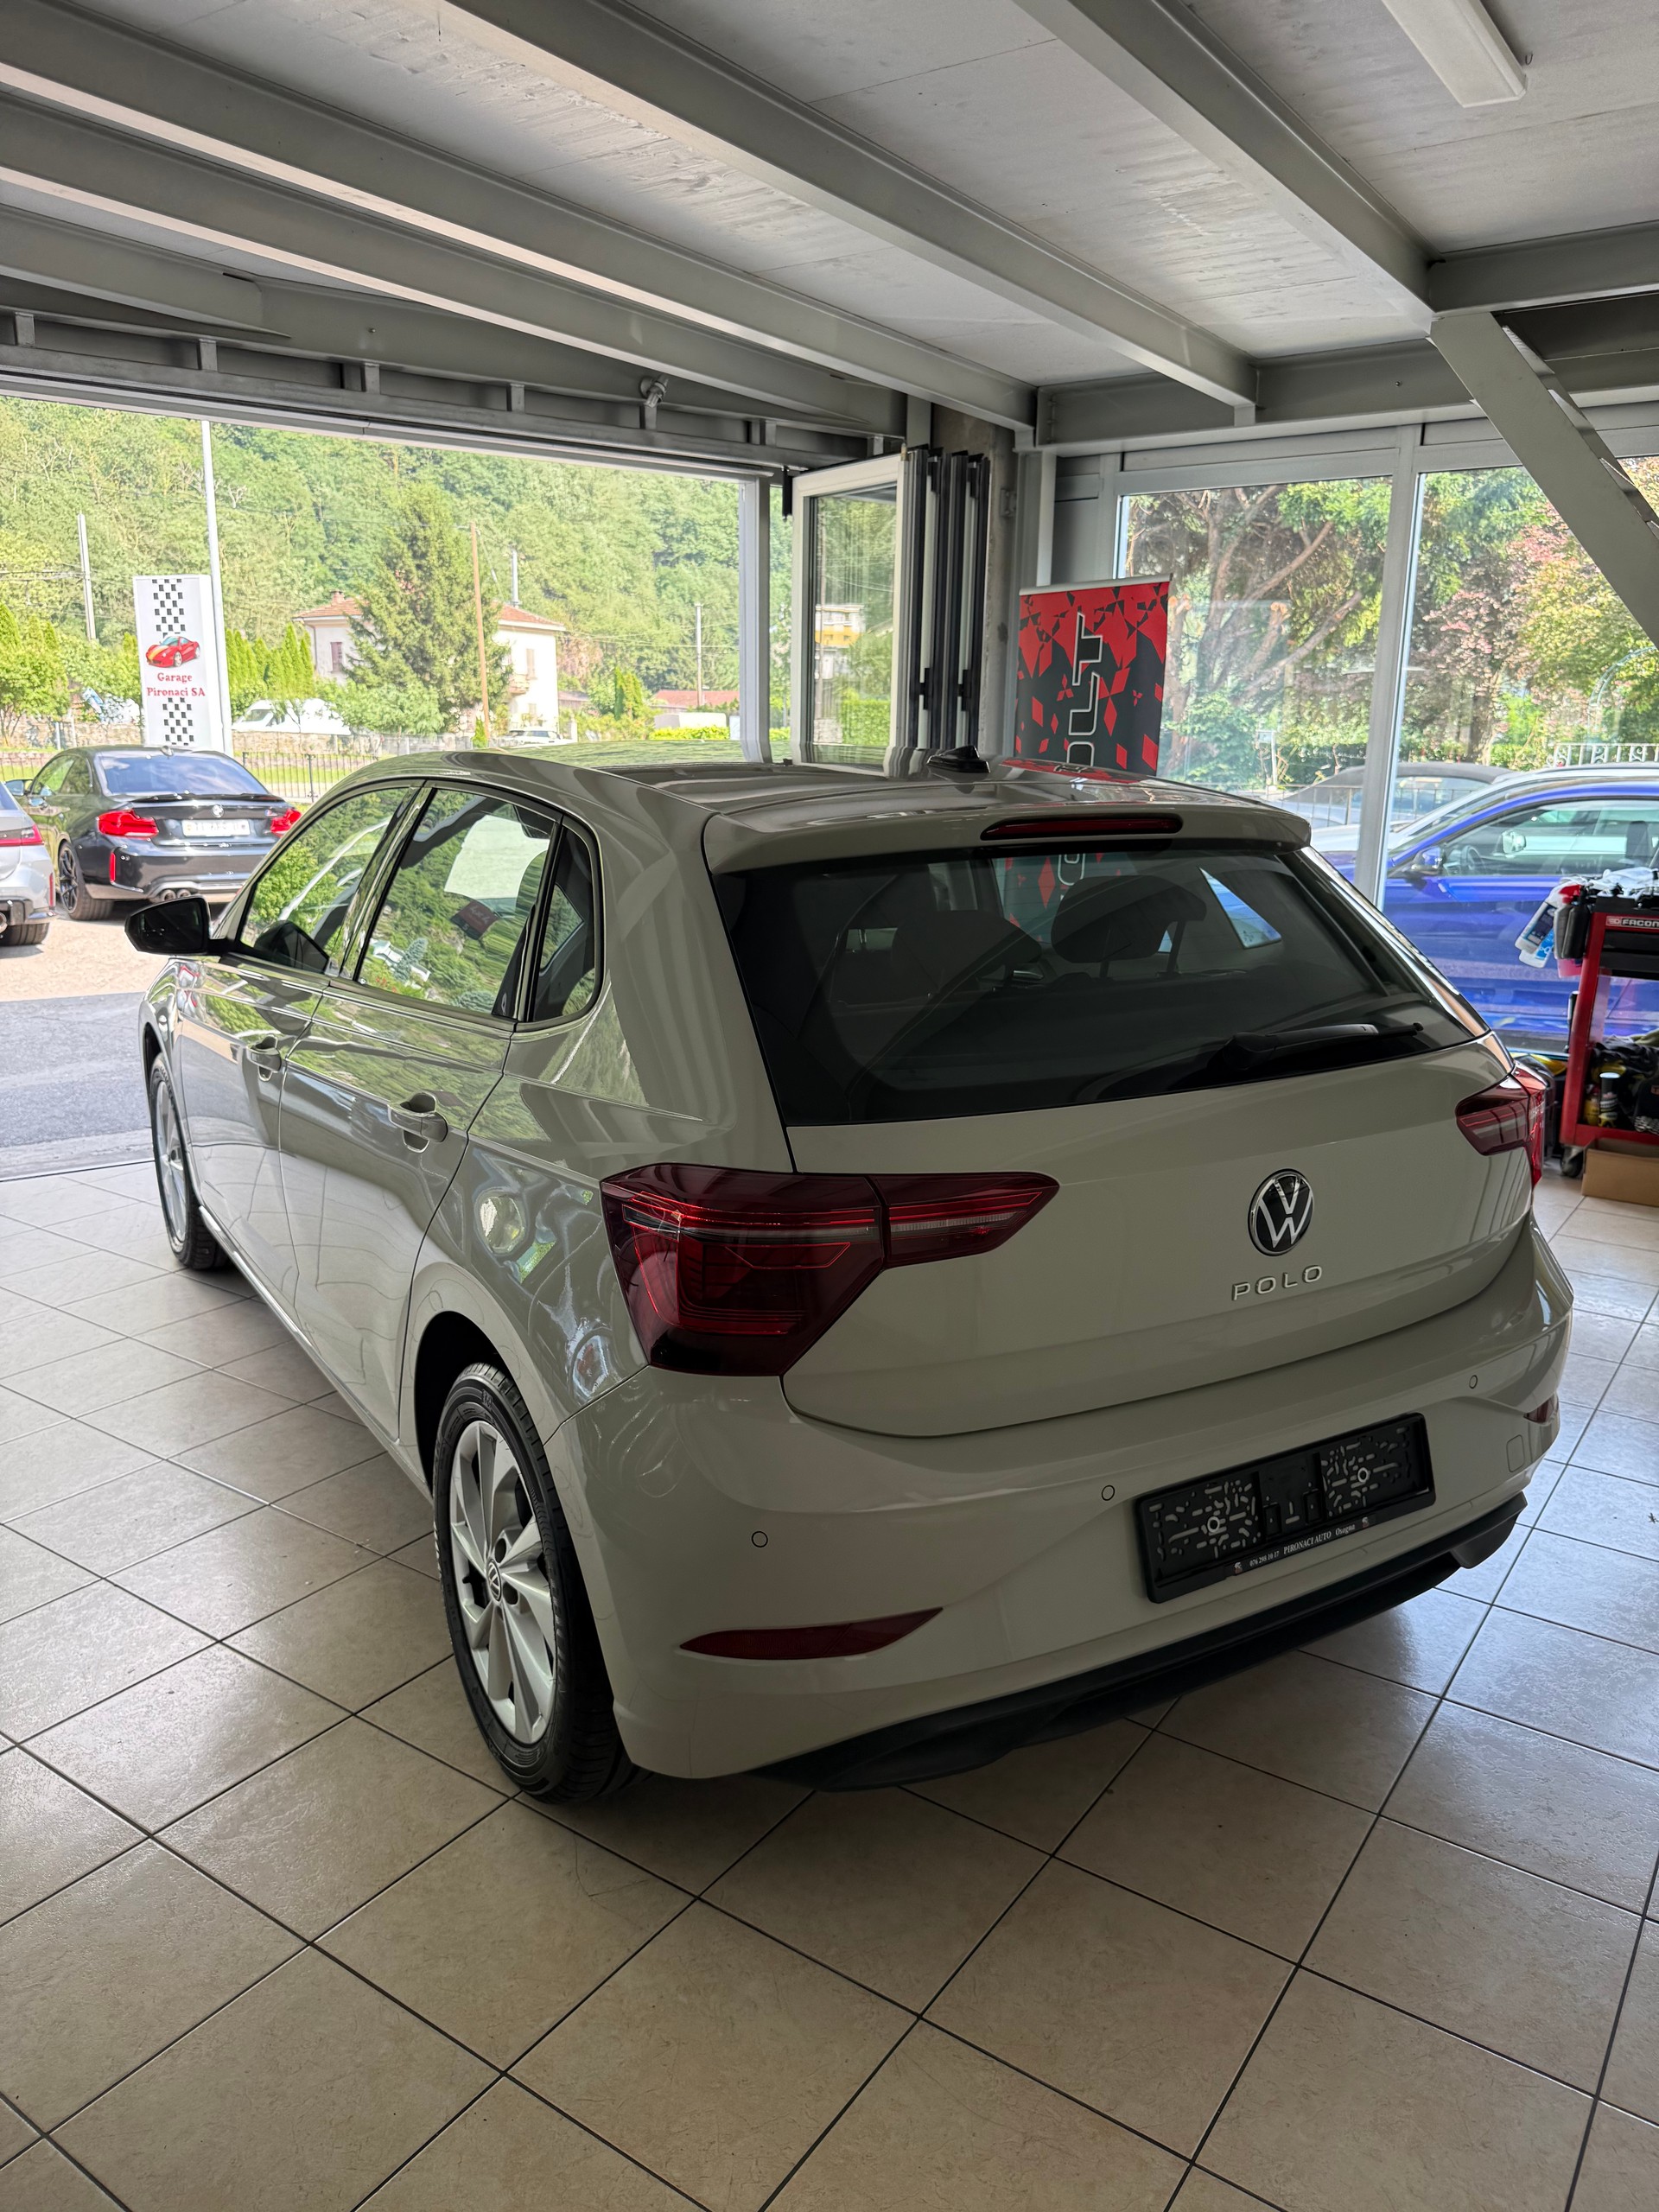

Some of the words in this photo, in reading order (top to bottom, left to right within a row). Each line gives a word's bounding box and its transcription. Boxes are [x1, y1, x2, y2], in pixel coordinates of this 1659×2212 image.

[157, 672, 192, 683] Garage
[147, 687, 188, 696] Pironaci
[191, 687, 206, 696] SA
[1232, 1265, 1322, 1300] POLO
[1283, 1537, 1314, 1555] PIRONACI
[1314, 1531, 1332, 1543] AUTO
